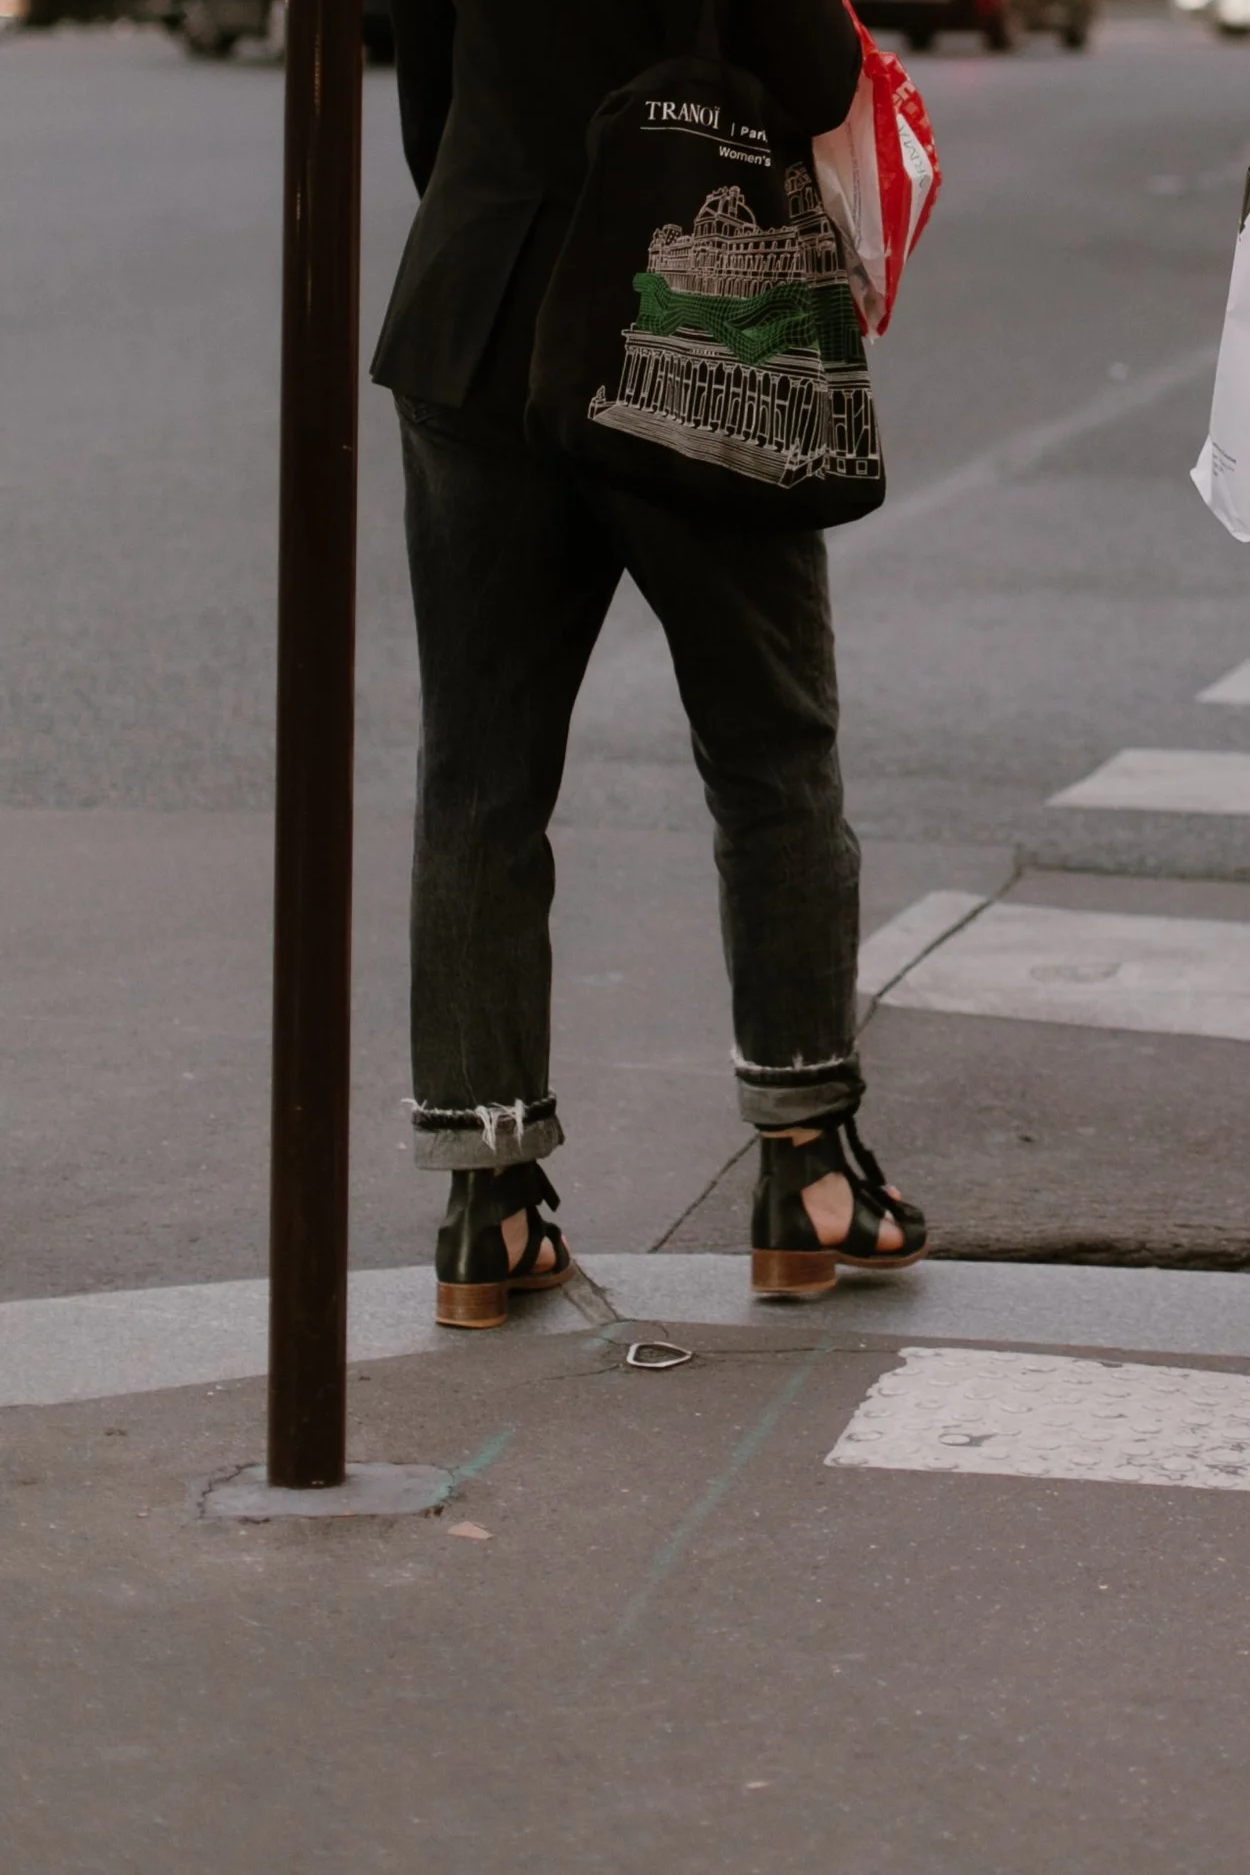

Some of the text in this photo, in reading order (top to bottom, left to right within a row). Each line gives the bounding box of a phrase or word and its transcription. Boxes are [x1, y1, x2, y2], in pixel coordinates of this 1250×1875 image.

[645, 101, 768, 142] TRANOÏ Pari
[719, 146, 771, 167] Women's
